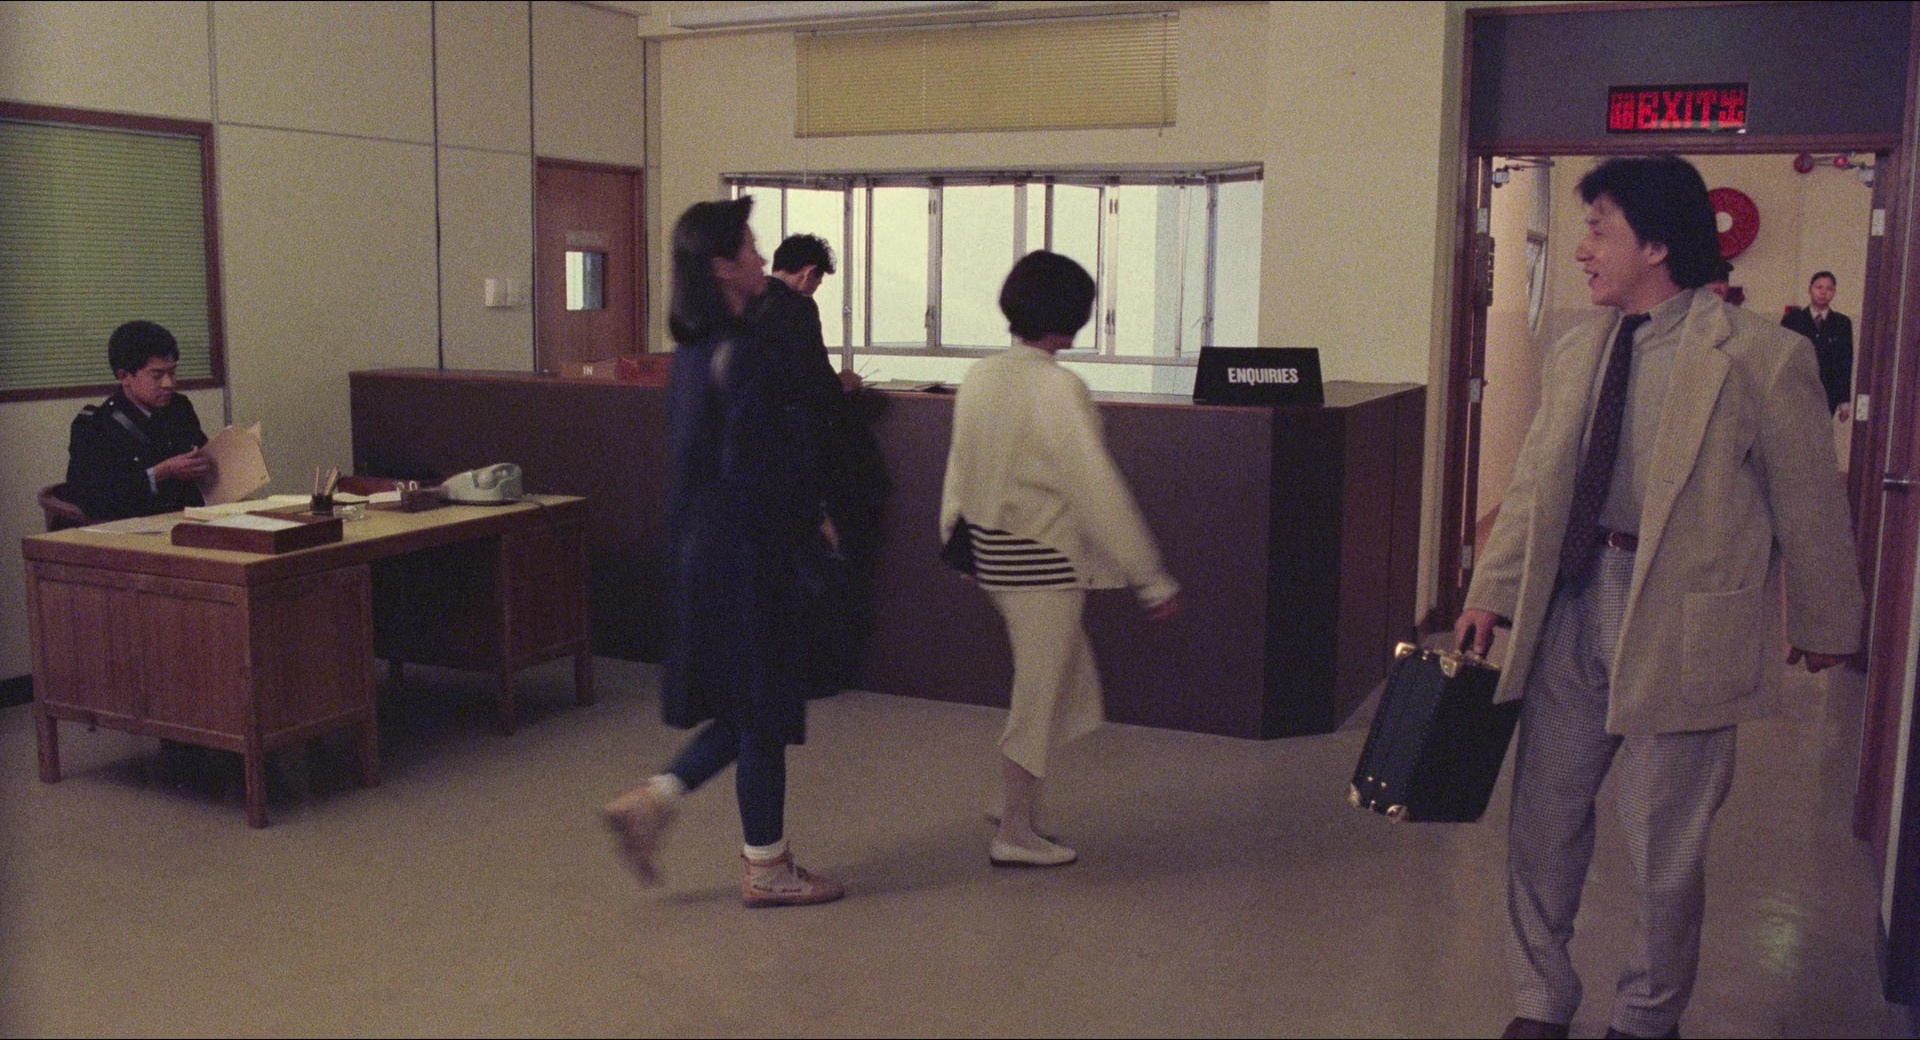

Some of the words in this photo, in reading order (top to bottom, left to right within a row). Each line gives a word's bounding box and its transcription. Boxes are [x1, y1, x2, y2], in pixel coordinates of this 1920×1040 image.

[1637, 90, 1718, 129] EXIT
[1718, 89, 1745, 128] 出
[583, 365, 593, 375] IN
[1227, 367, 1299, 386] ENQUIRIES
